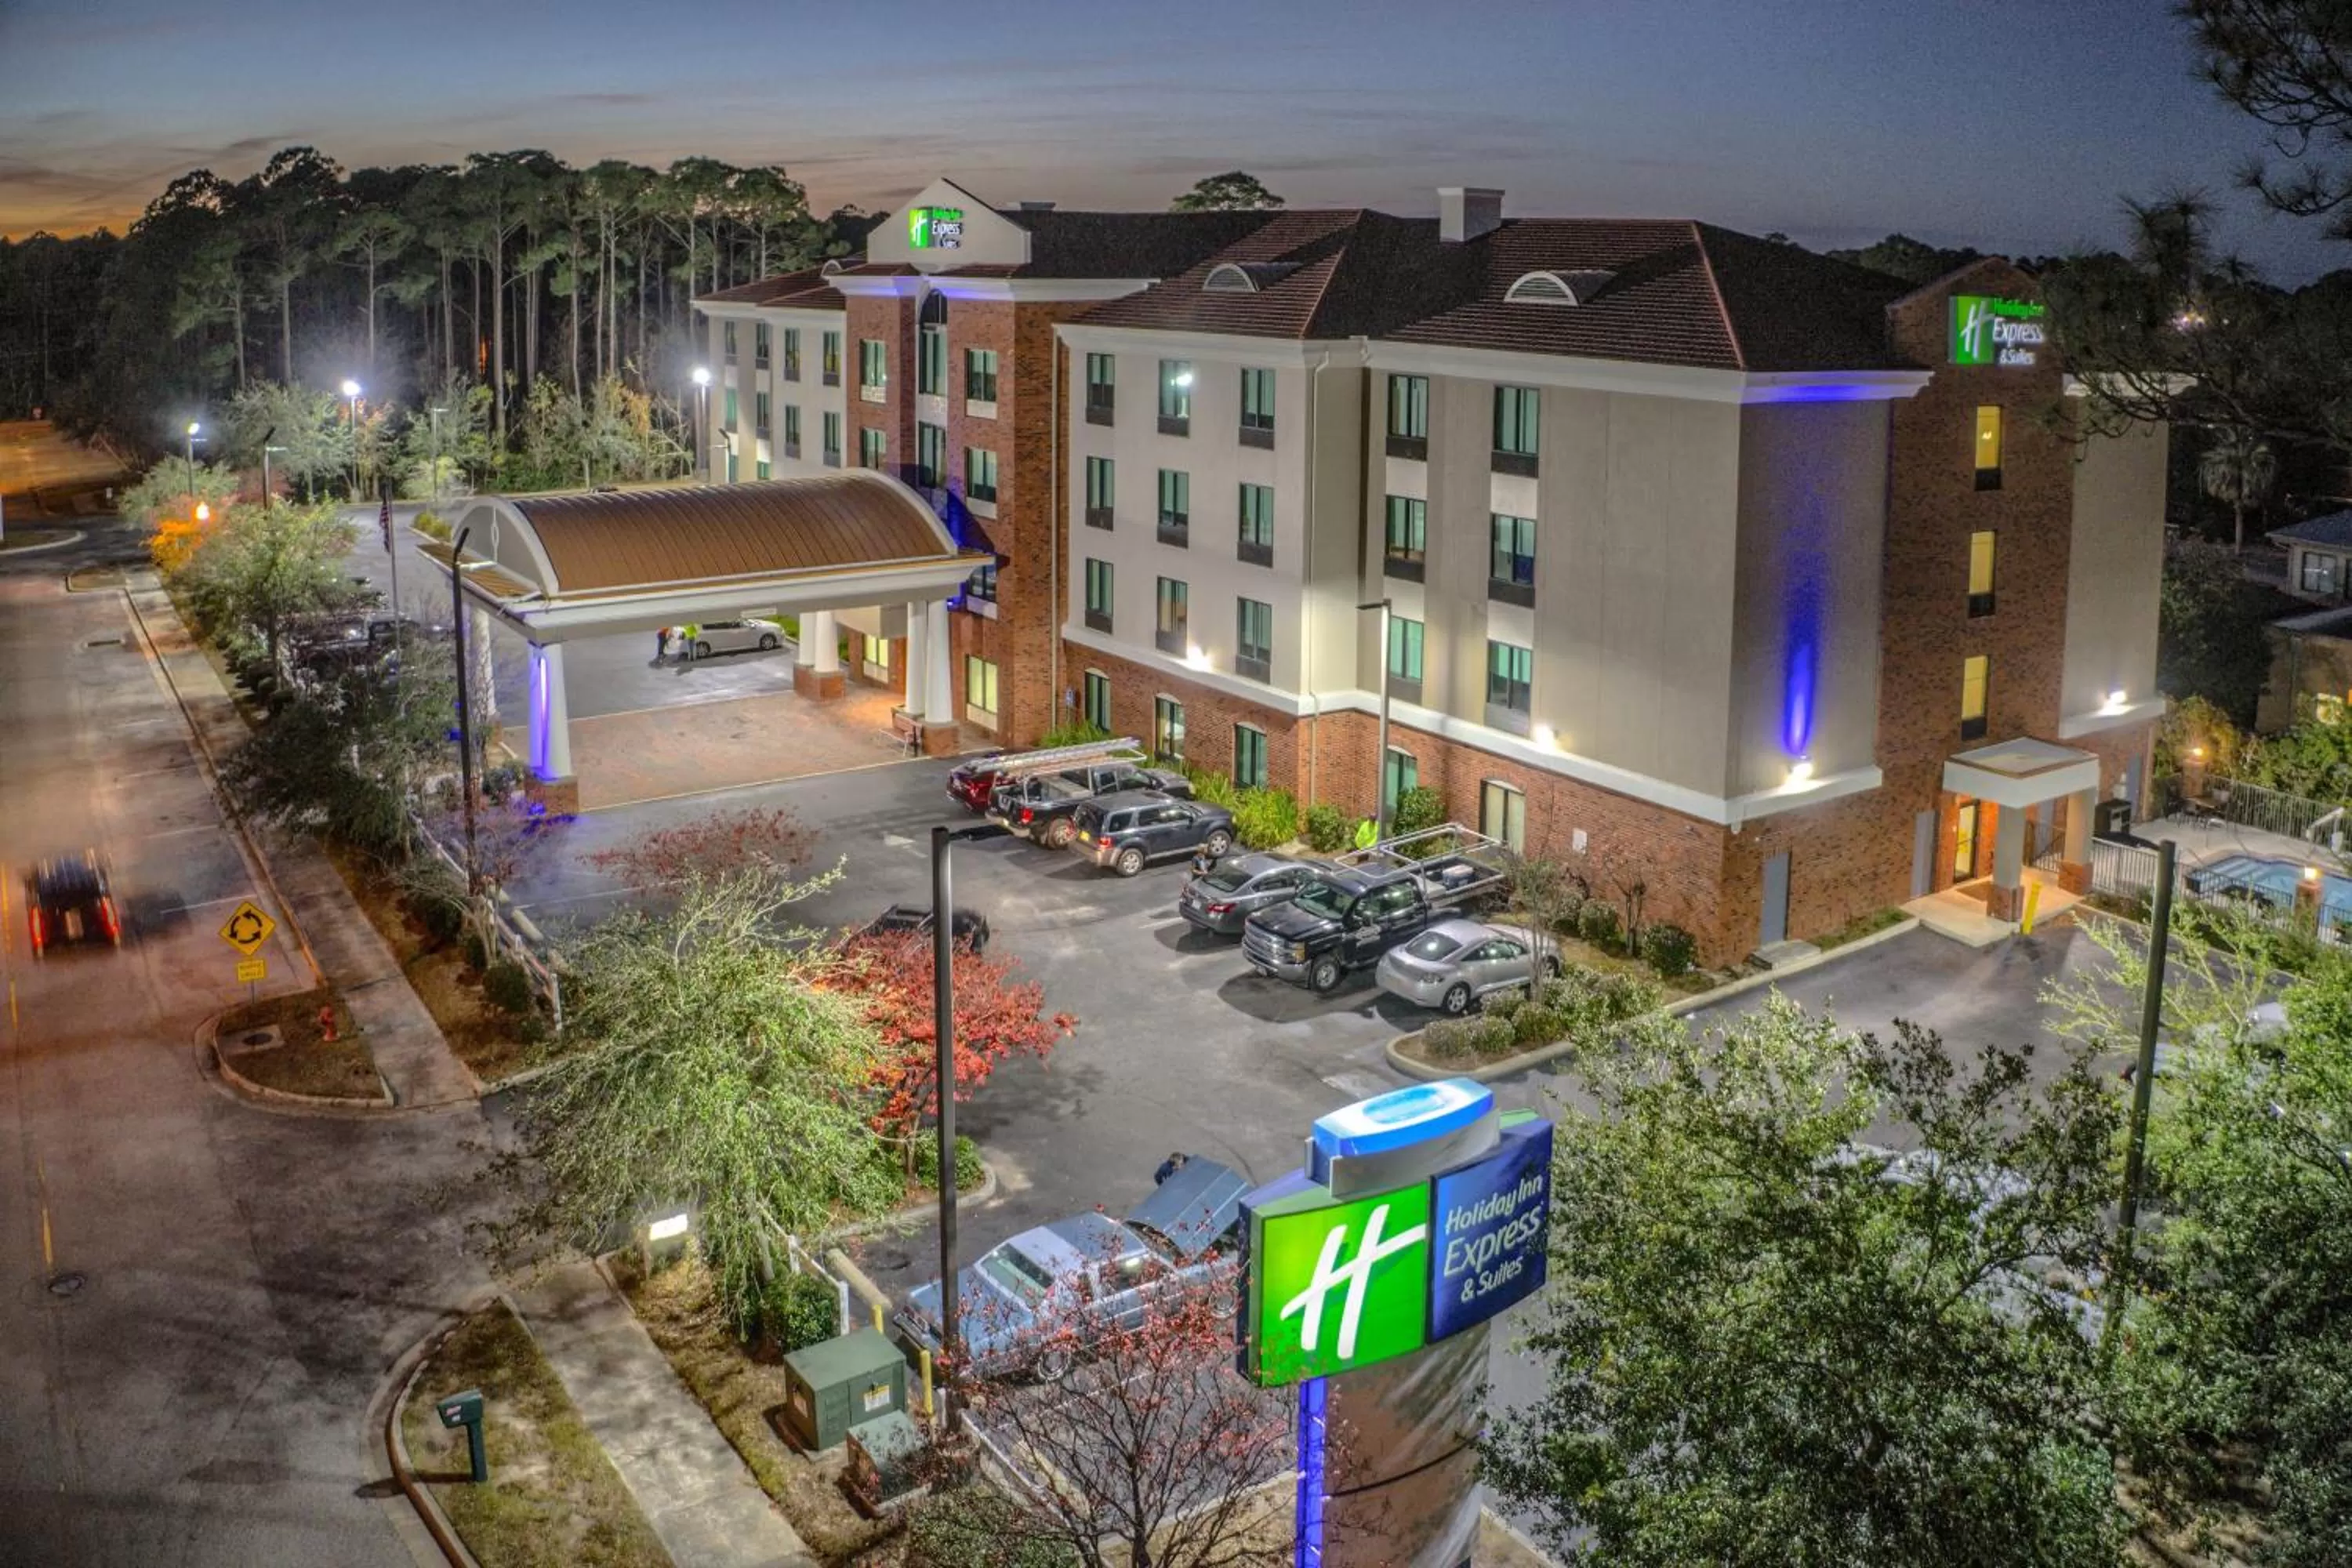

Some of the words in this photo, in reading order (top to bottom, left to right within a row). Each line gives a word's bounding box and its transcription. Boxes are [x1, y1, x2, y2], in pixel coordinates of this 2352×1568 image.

[1993, 317, 2045, 347] Express
[1445, 1190, 1517, 1236] Holiday
[1518, 1174, 1544, 1203] Inn
[1443, 1206, 1542, 1277] Express
[1461, 1278, 1475, 1303] &
[1477, 1255, 1524, 1296] Suites
